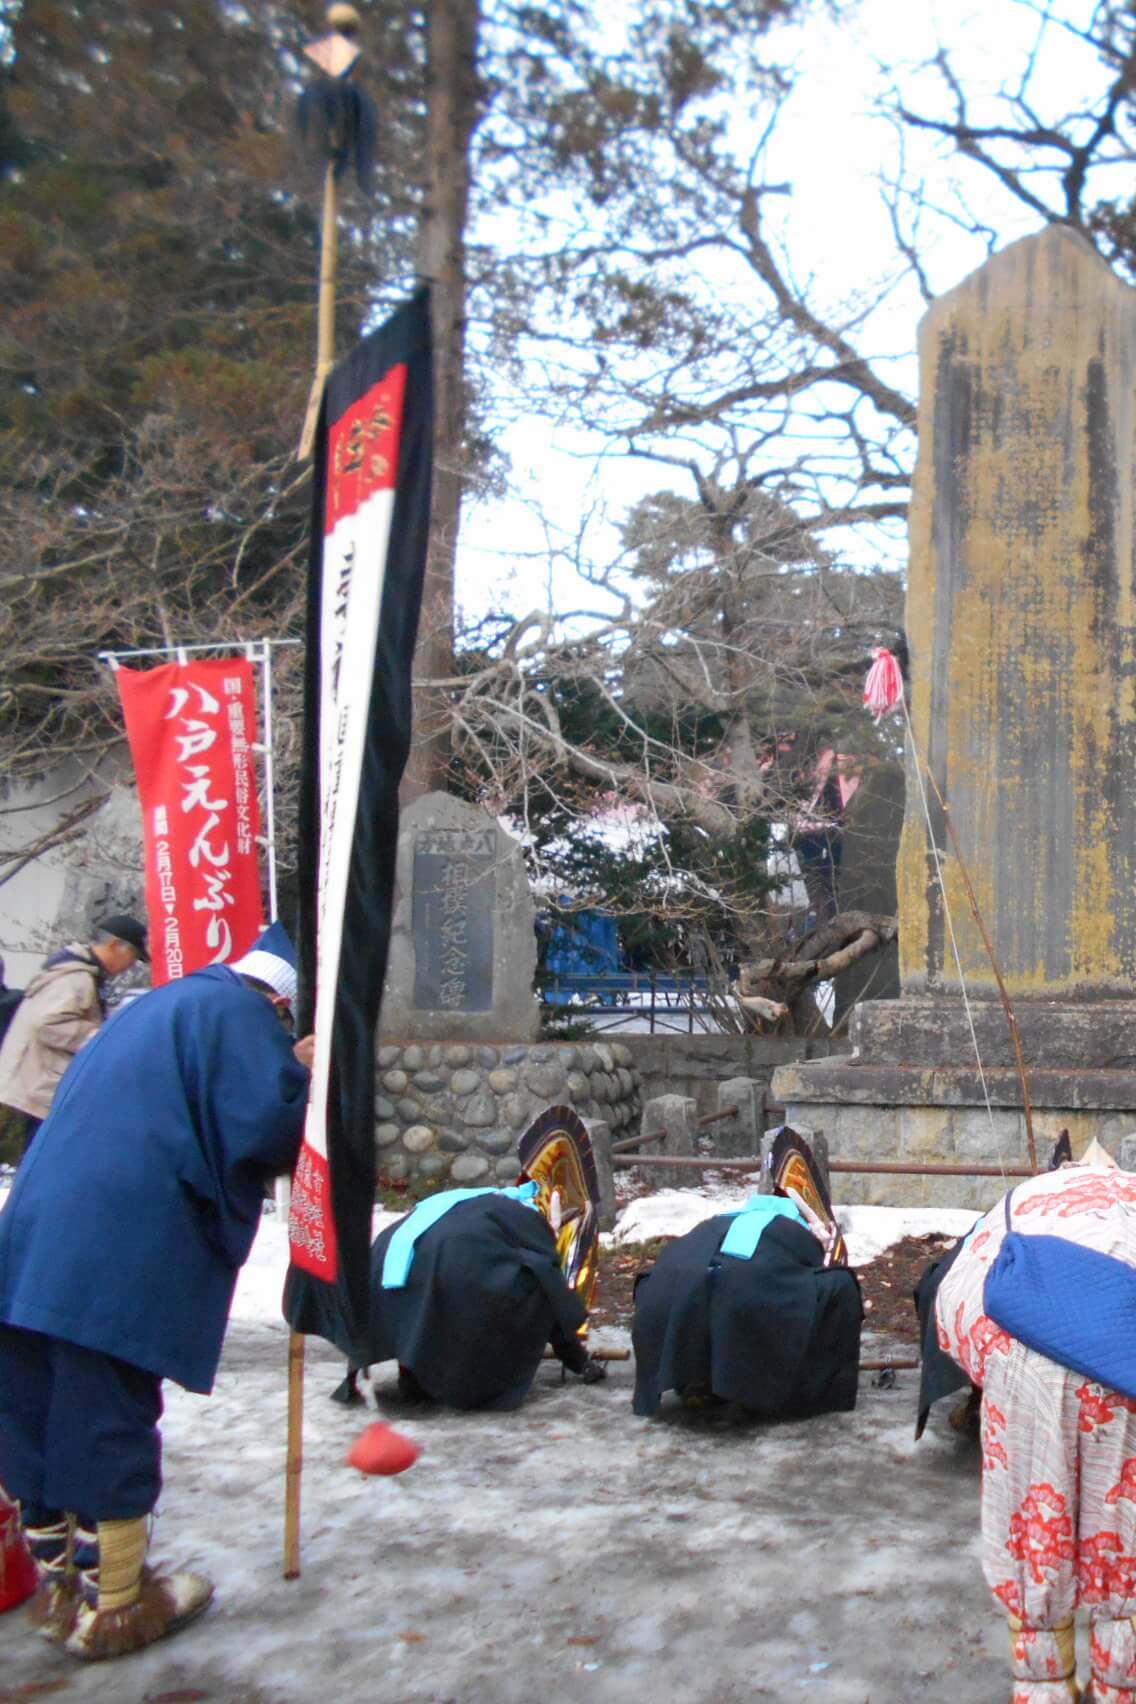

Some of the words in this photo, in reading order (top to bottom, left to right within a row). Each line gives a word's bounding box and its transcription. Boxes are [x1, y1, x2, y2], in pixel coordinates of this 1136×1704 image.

[164, 680, 236, 965] 八戸えんぶり
